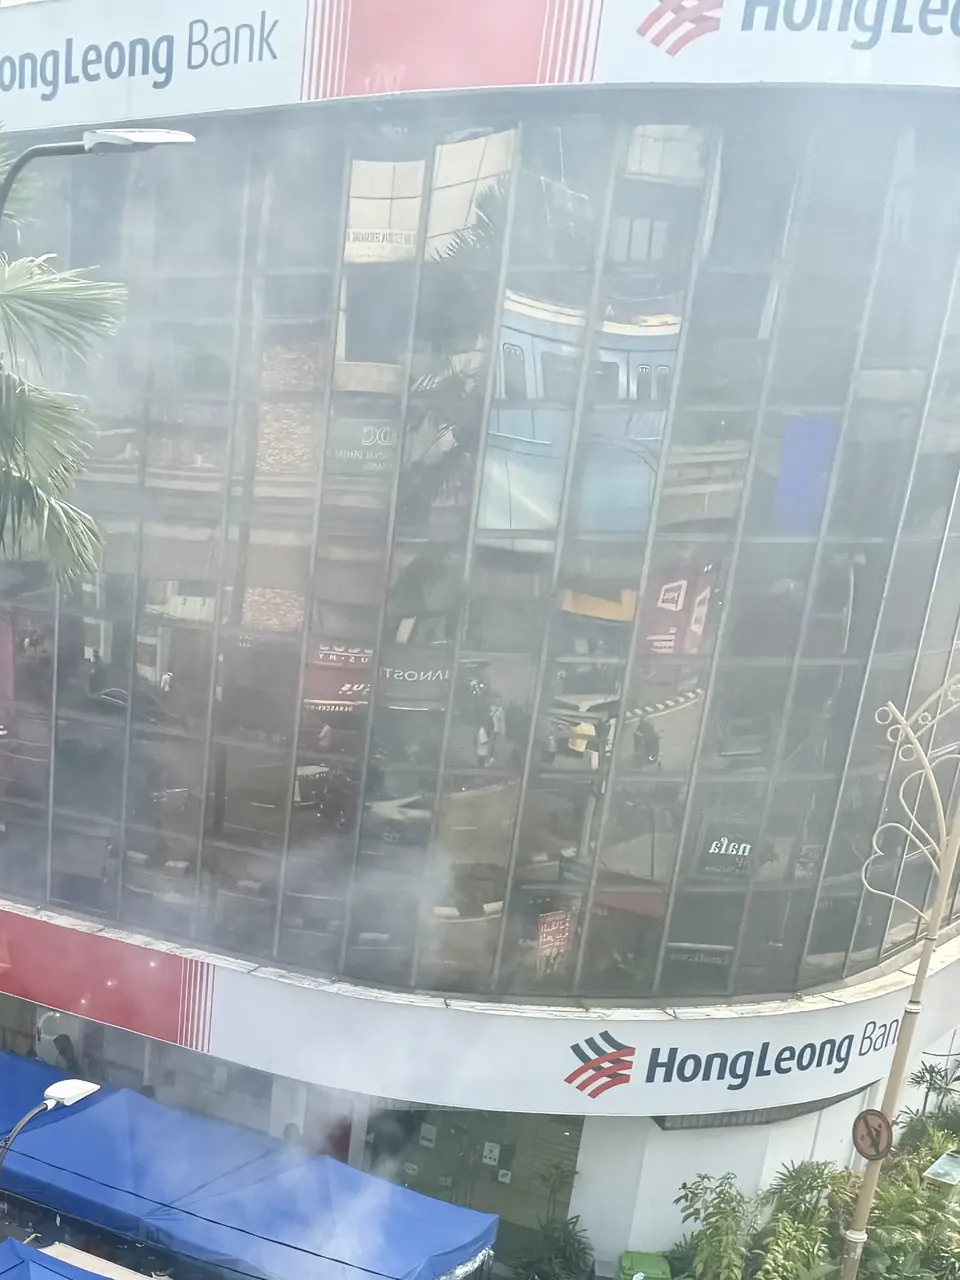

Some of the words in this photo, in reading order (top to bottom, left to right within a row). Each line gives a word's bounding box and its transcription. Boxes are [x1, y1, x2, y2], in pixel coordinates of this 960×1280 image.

[187, 11, 279, 70] Bank
[741, 0, 960, 50] HongLe
[645, 1034, 854, 1090] HongLeong
[859, 1018, 899, 1057] Ban
